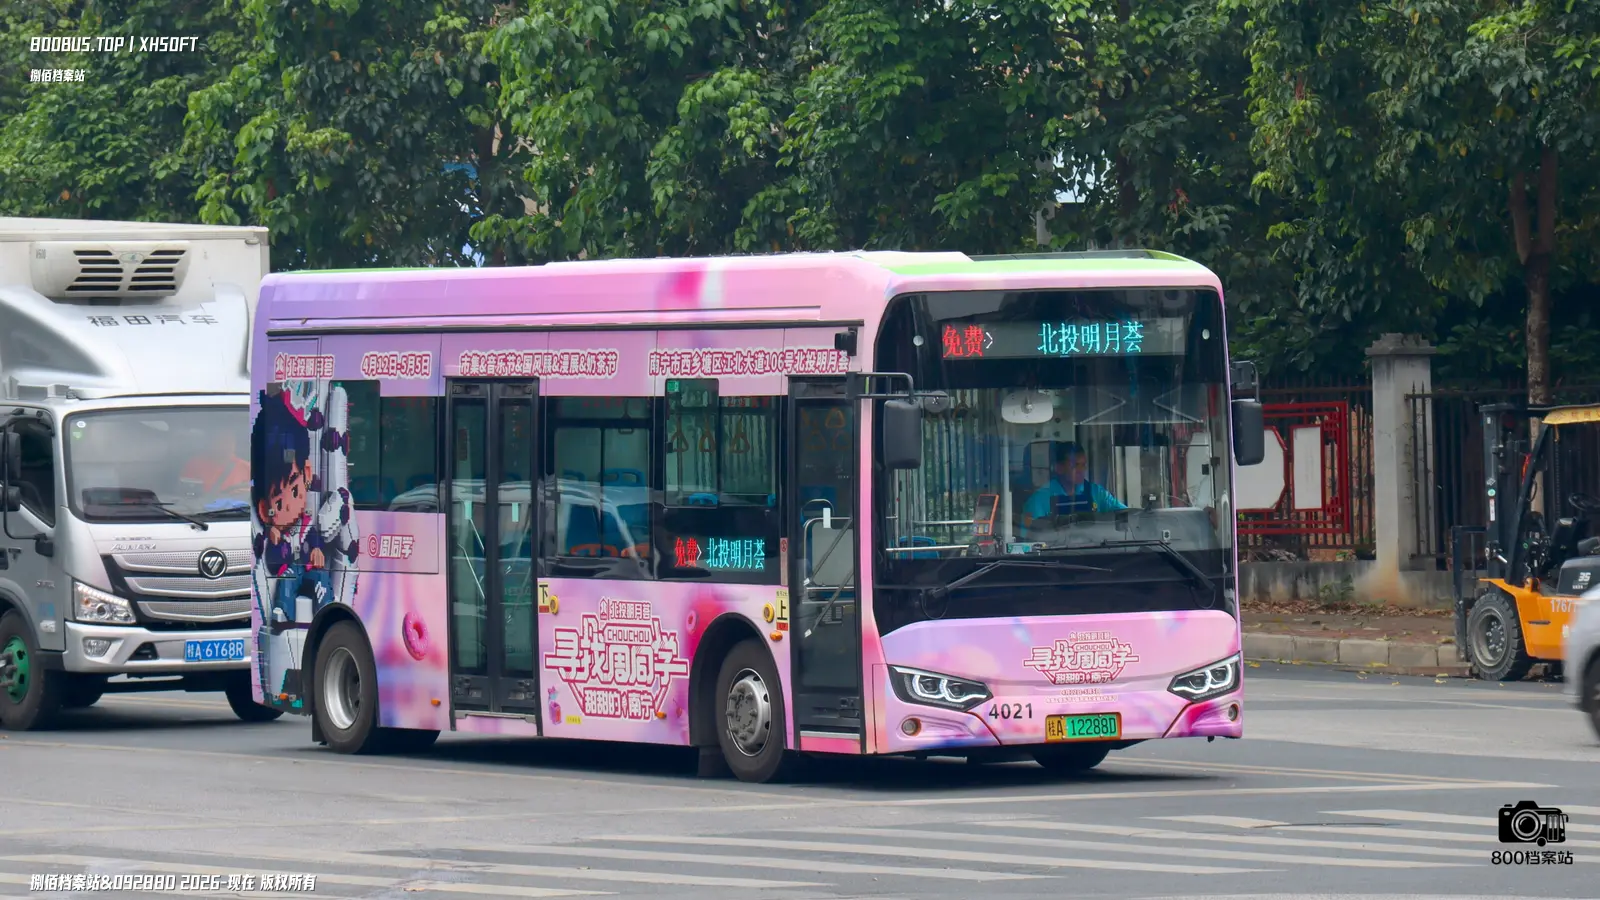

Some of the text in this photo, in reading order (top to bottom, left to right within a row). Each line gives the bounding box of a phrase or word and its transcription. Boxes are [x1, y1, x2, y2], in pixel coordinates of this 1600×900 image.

[86, 315, 219, 327] 福田汽车
[943, 321, 1144, 358] 免费 北投明月荟
[361, 353, 431, 376] 4月12日-5月5日
[460, 352, 618, 376] 市集&音乐节&国风展&漫展&奶茶节
[674, 537, 698, 568] 免费
[705, 537, 766, 570] 北投明月荟
[538, 584, 549, 604] 下
[776, 599, 788, 620] 上
[607, 629, 650, 642] CHOUCHOU
[545, 615, 688, 687] 寻找周同学
[988, 702, 1033, 720] 4021
